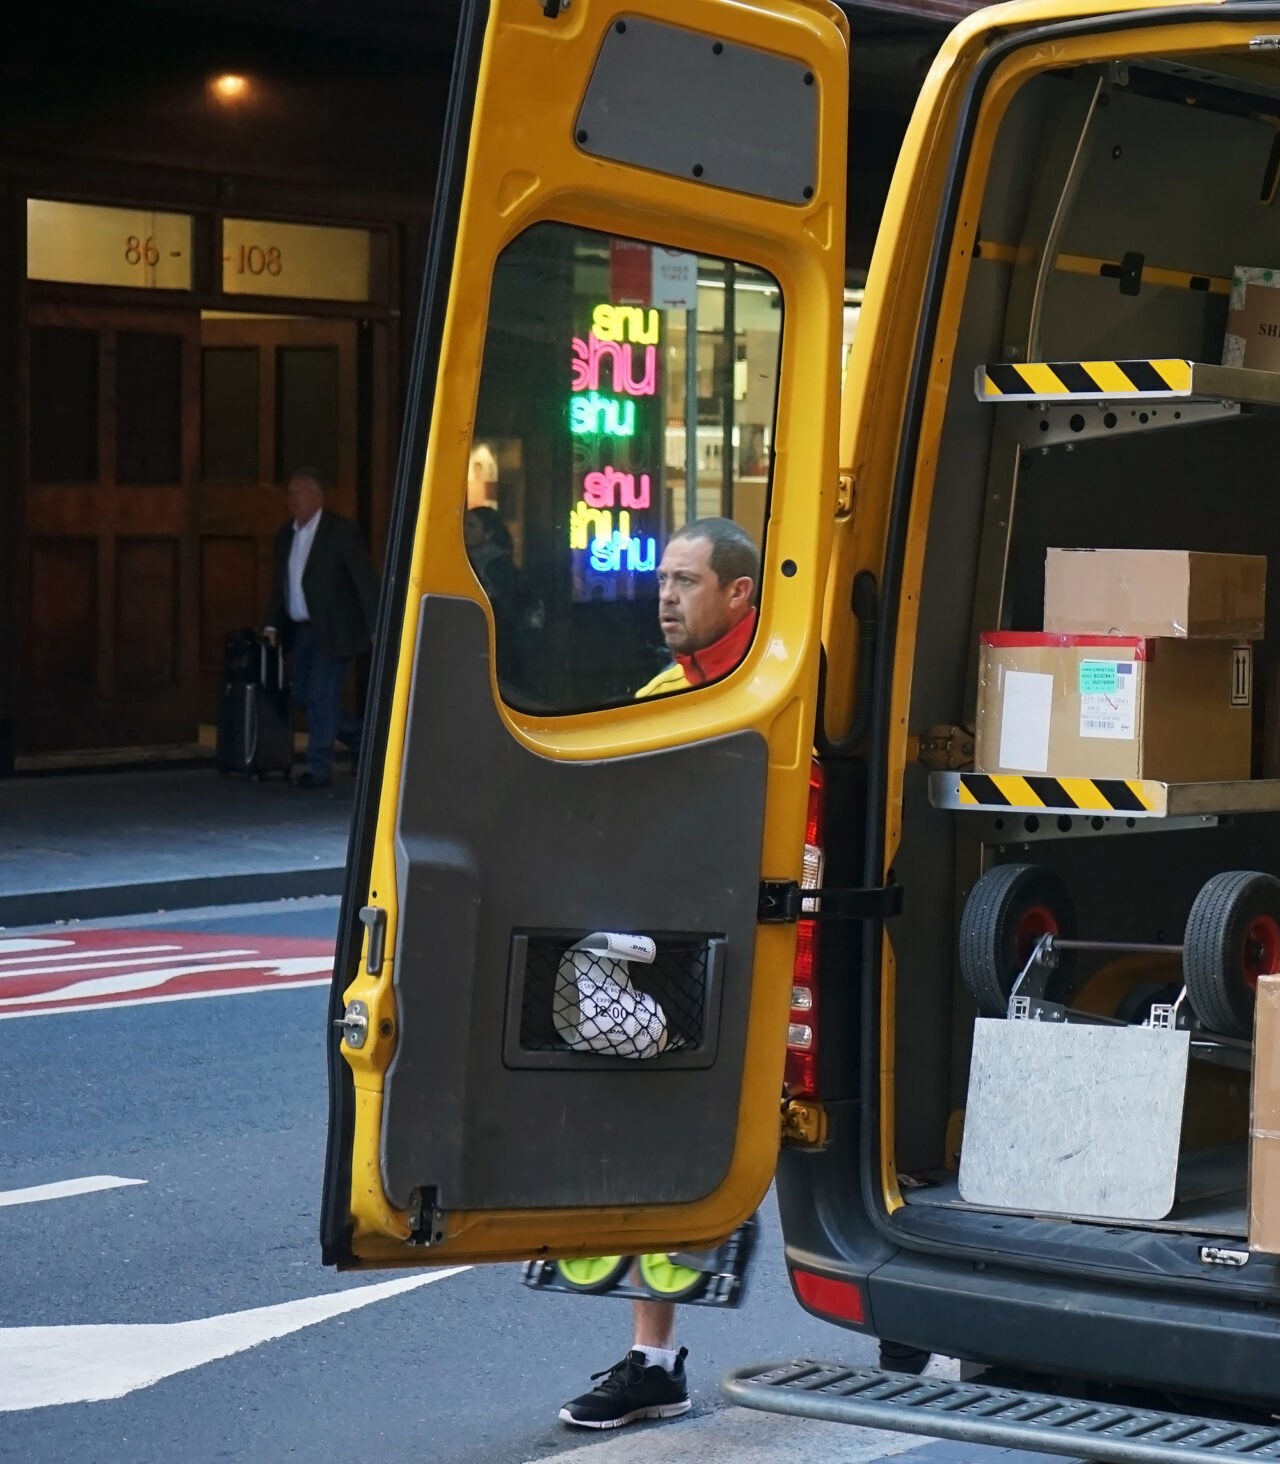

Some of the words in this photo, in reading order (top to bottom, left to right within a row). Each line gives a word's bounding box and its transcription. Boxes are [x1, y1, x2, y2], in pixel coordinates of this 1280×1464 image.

[583, 465, 651, 510] shu
[590, 530, 657, 572] shu
[592, 1004, 628, 1020] 12:00
